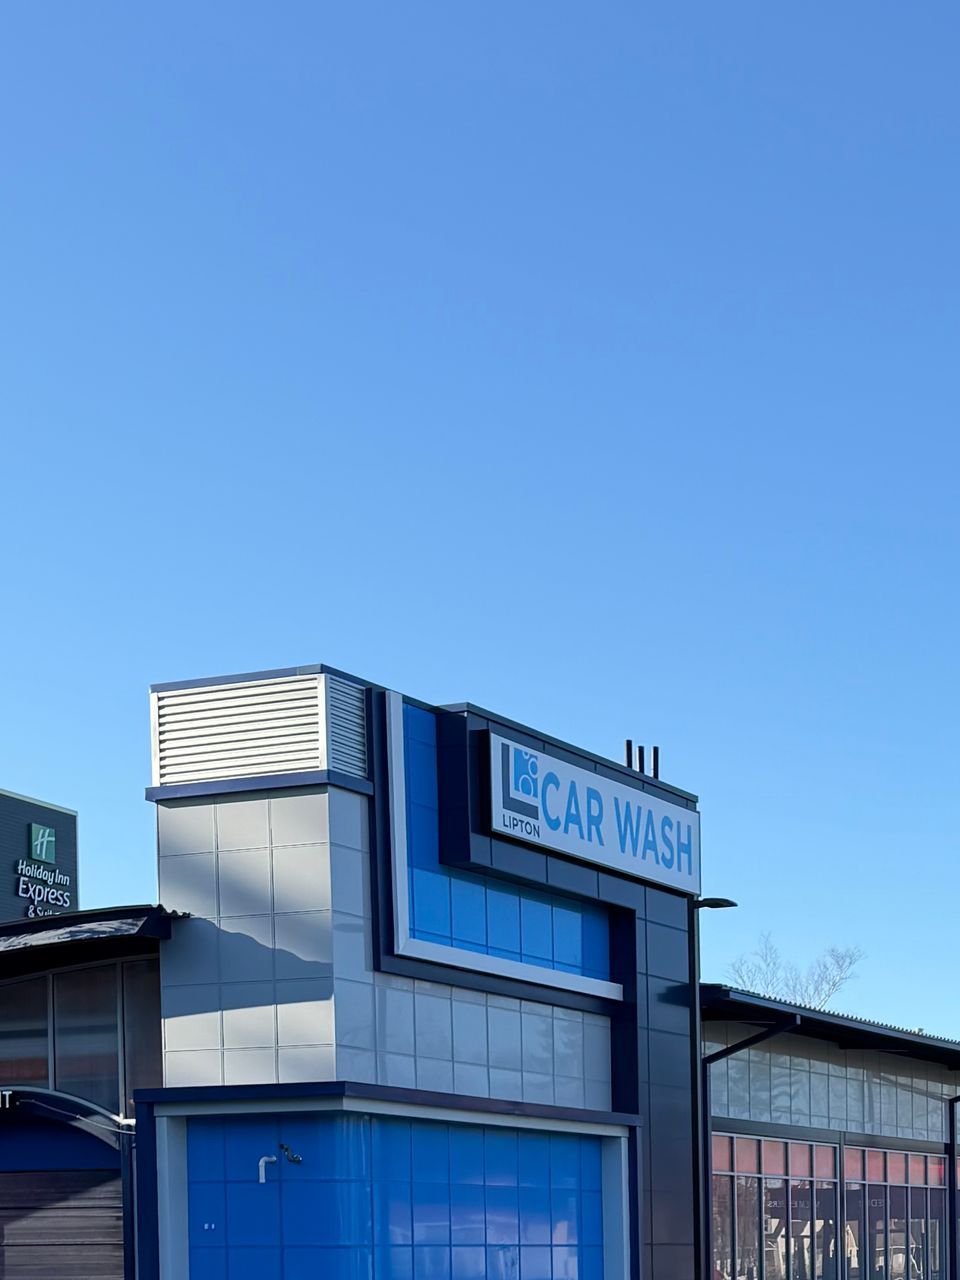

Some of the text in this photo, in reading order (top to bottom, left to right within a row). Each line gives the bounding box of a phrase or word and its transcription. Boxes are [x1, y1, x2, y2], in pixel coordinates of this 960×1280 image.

[502, 813, 541, 839] LIPTON
[541, 771, 693, 876] CAR WASH
[17, 859, 70, 886] Holiday Inn
[18, 876, 71, 907] Express
[28, 904, 35, 918] &
